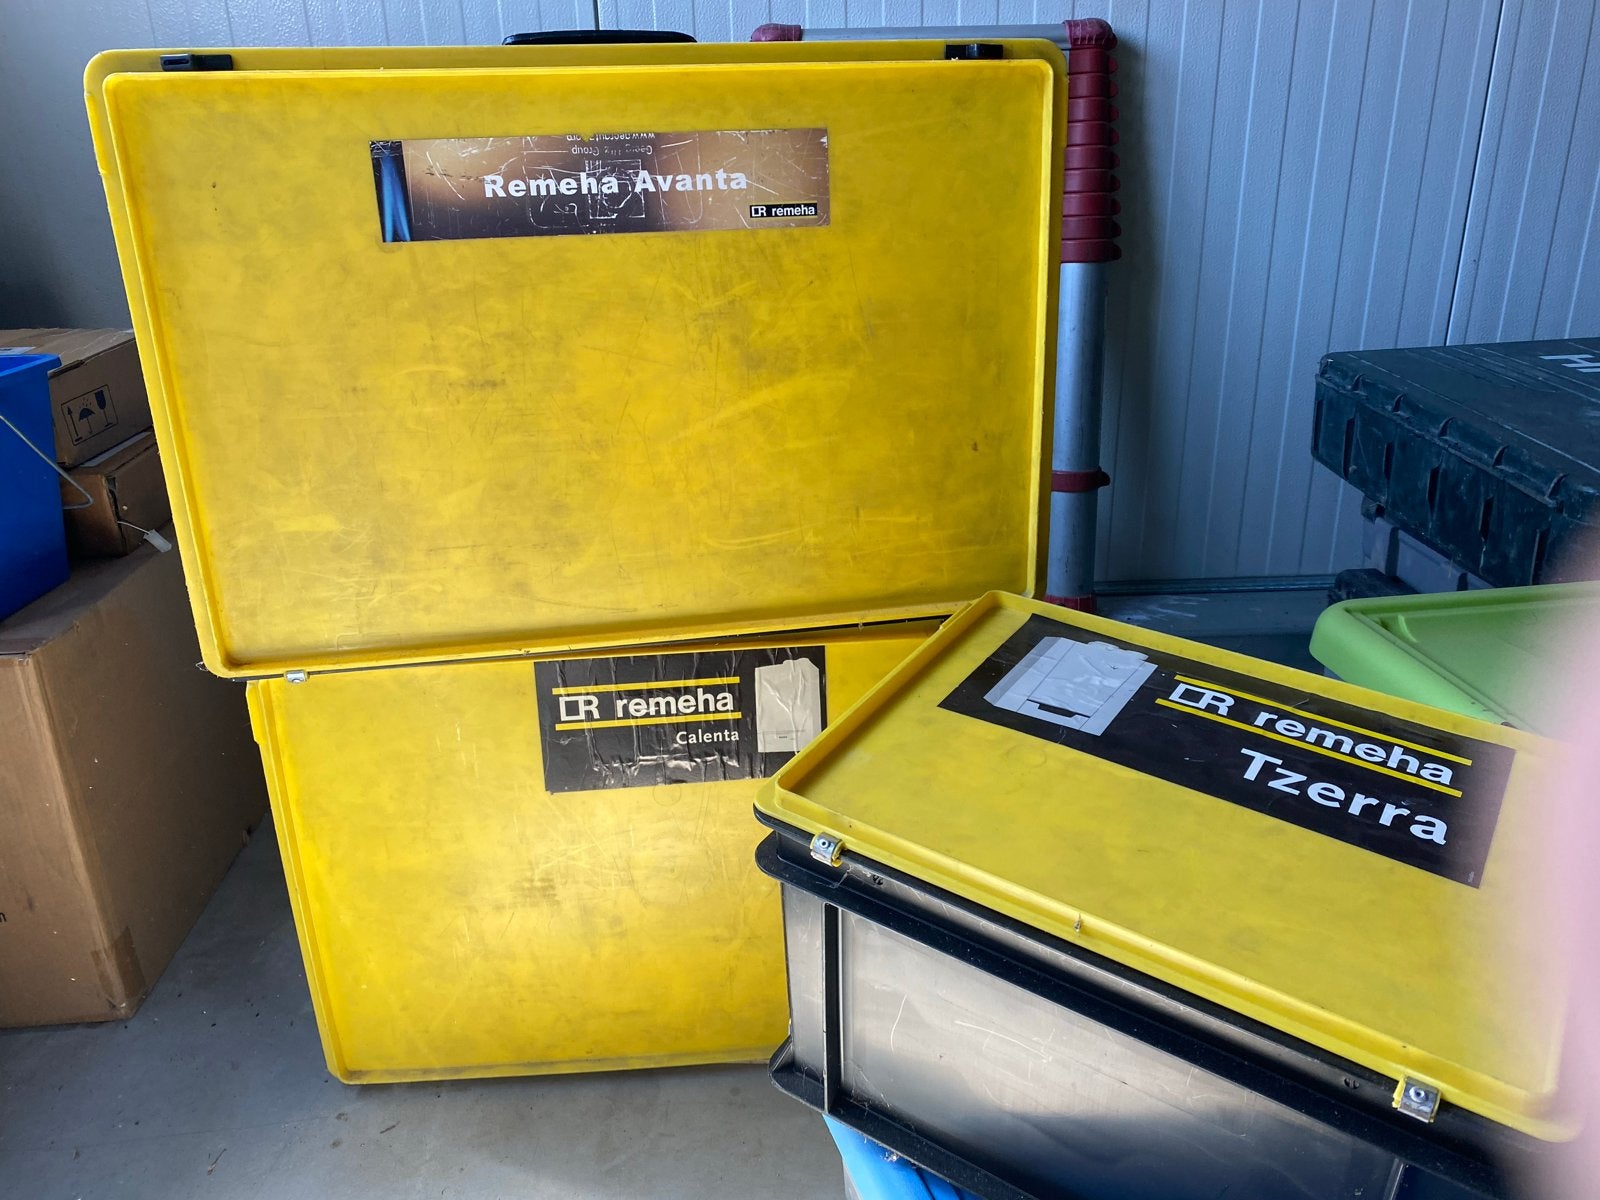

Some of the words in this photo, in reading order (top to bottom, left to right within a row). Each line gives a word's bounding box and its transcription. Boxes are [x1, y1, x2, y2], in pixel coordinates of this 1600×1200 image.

[571, 144, 600, 156] Group
[484, 171, 619, 198] Remeha
[634, 168, 749, 193] Avanta
[771, 204, 816, 217] remeha
[616, 688, 734, 718] remeha
[676, 728, 740, 745] Calenta
[1253, 711, 1455, 786] remeha
[1240, 748, 1449, 846] Tzerra
